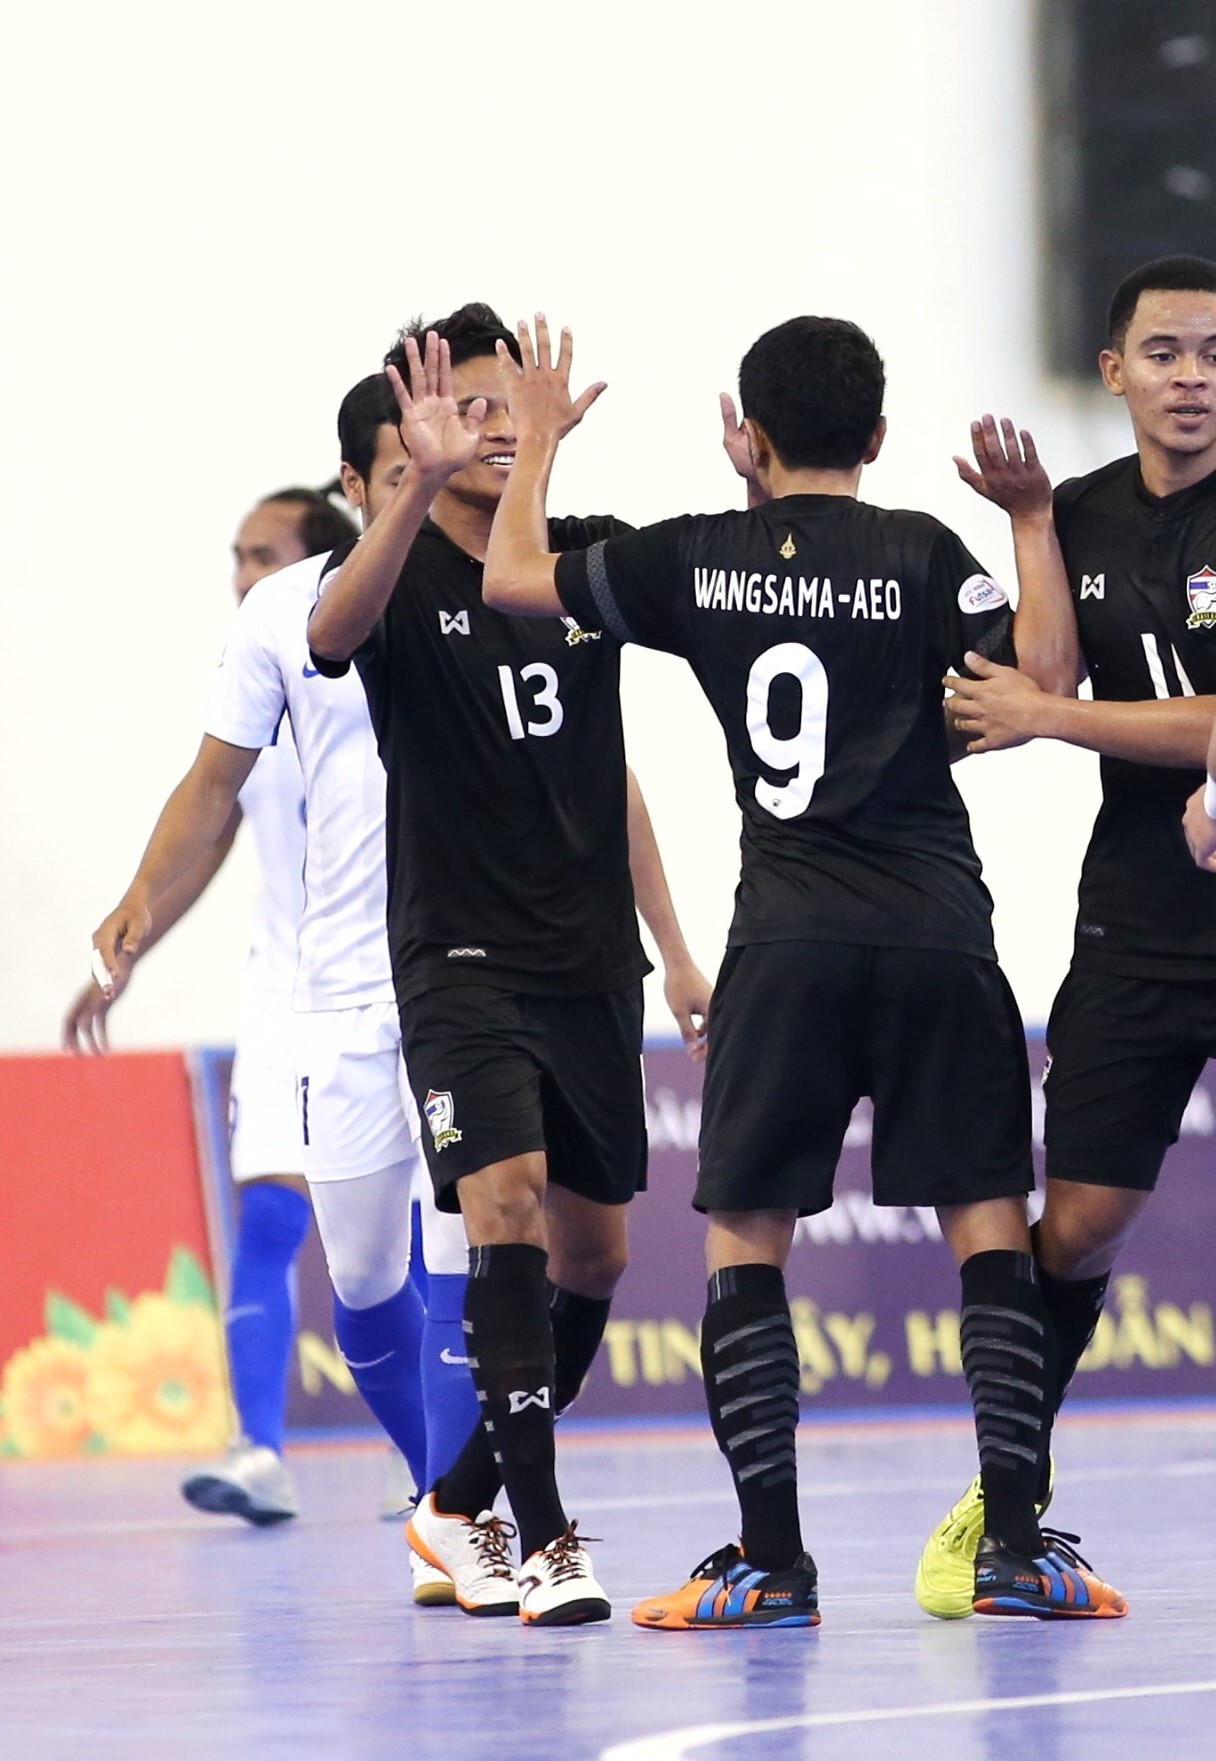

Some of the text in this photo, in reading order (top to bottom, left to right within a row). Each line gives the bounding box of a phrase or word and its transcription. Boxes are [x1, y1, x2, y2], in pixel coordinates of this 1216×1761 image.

[694, 566, 902, 621] WANGSAMA-AEO
[498, 662, 565, 740] 13
[1140, 632, 1198, 700] 11
[745, 641, 829, 820] 9
